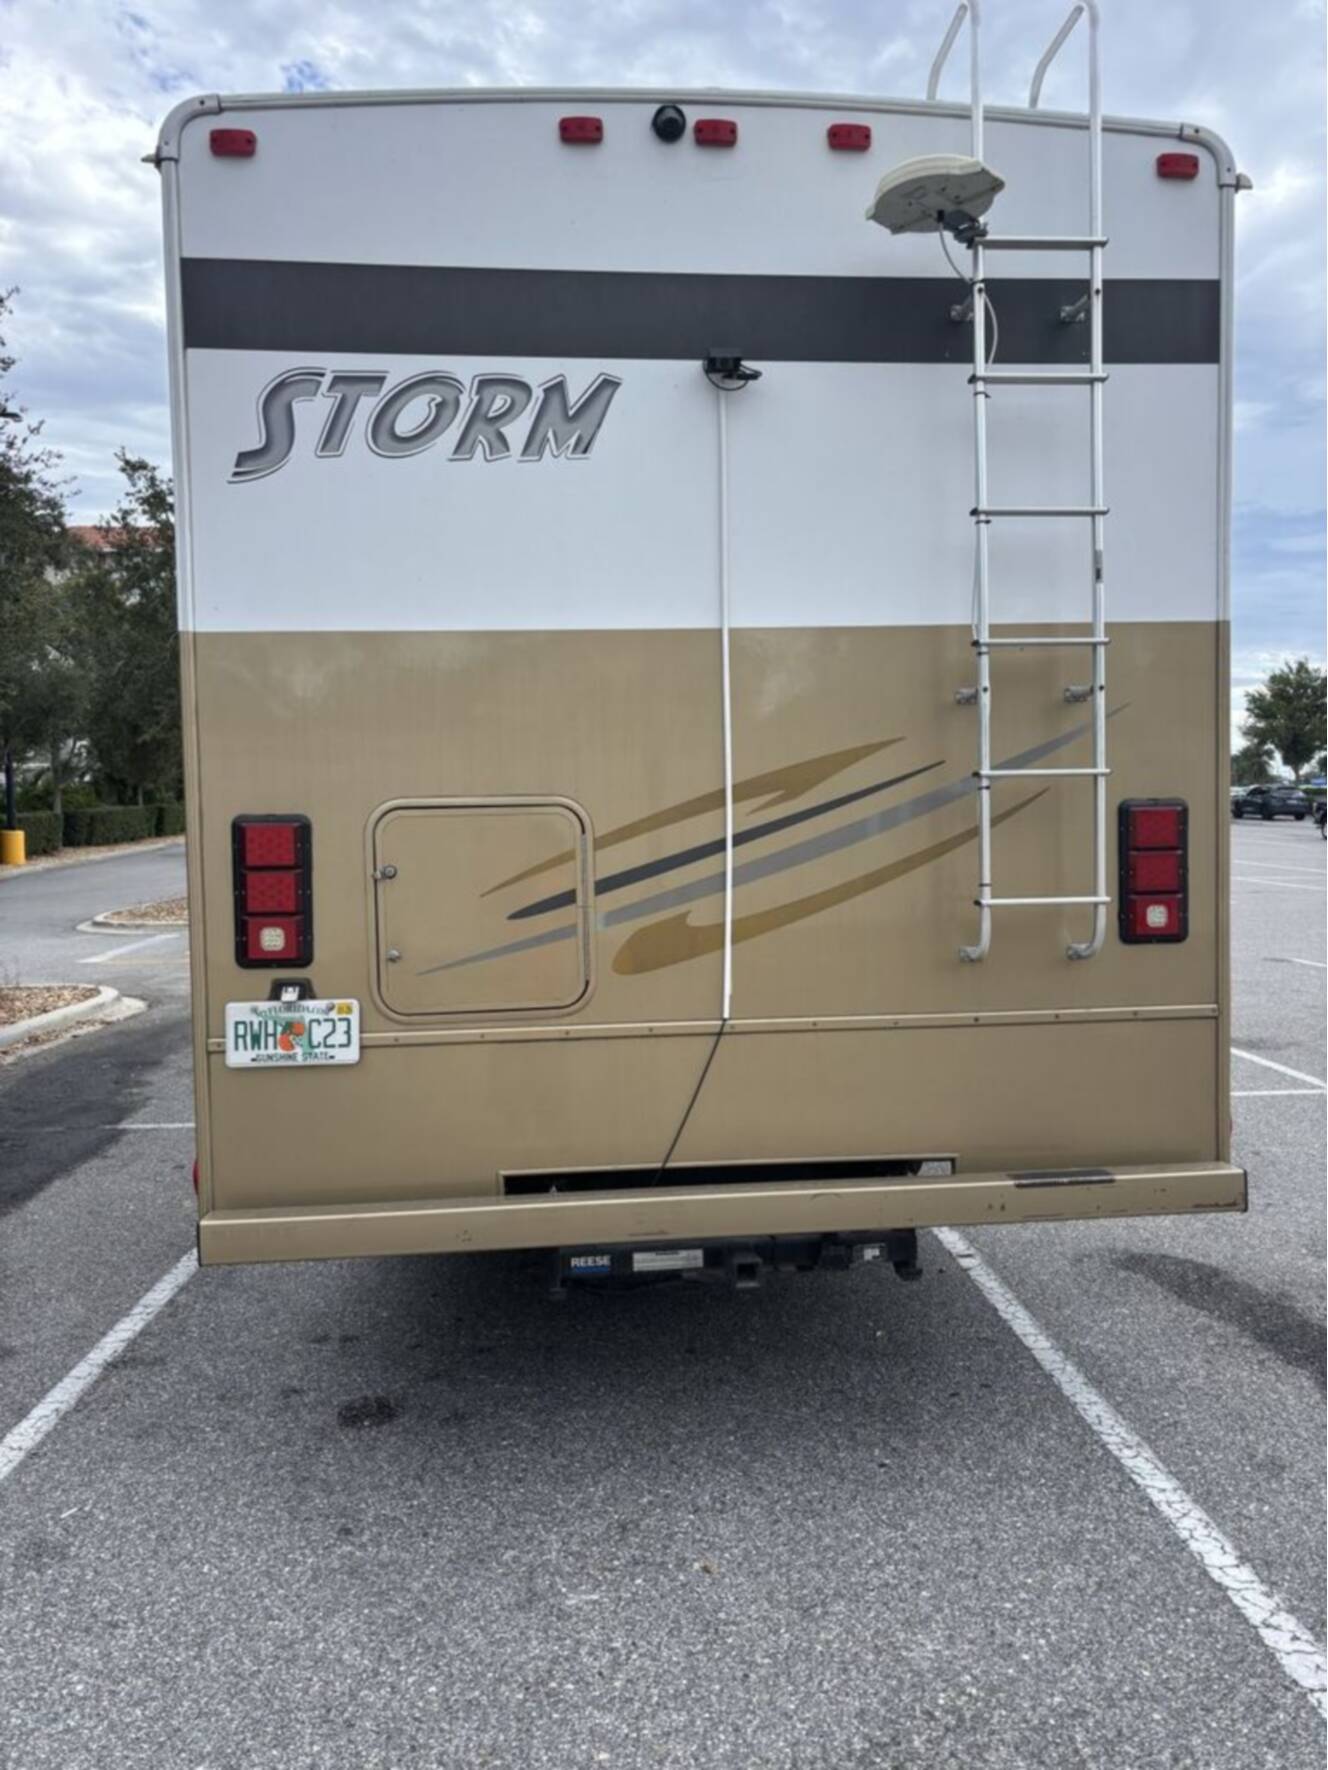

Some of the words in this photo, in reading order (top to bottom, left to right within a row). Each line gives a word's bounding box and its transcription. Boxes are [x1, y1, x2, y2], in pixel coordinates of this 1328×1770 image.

[227, 366, 622, 484] STORM
[234, 1020, 278, 1051] RWH
[308, 1018, 352, 1049] C23
[302, 1051, 329, 1062] STATE
[570, 1254, 611, 1267] REESE
